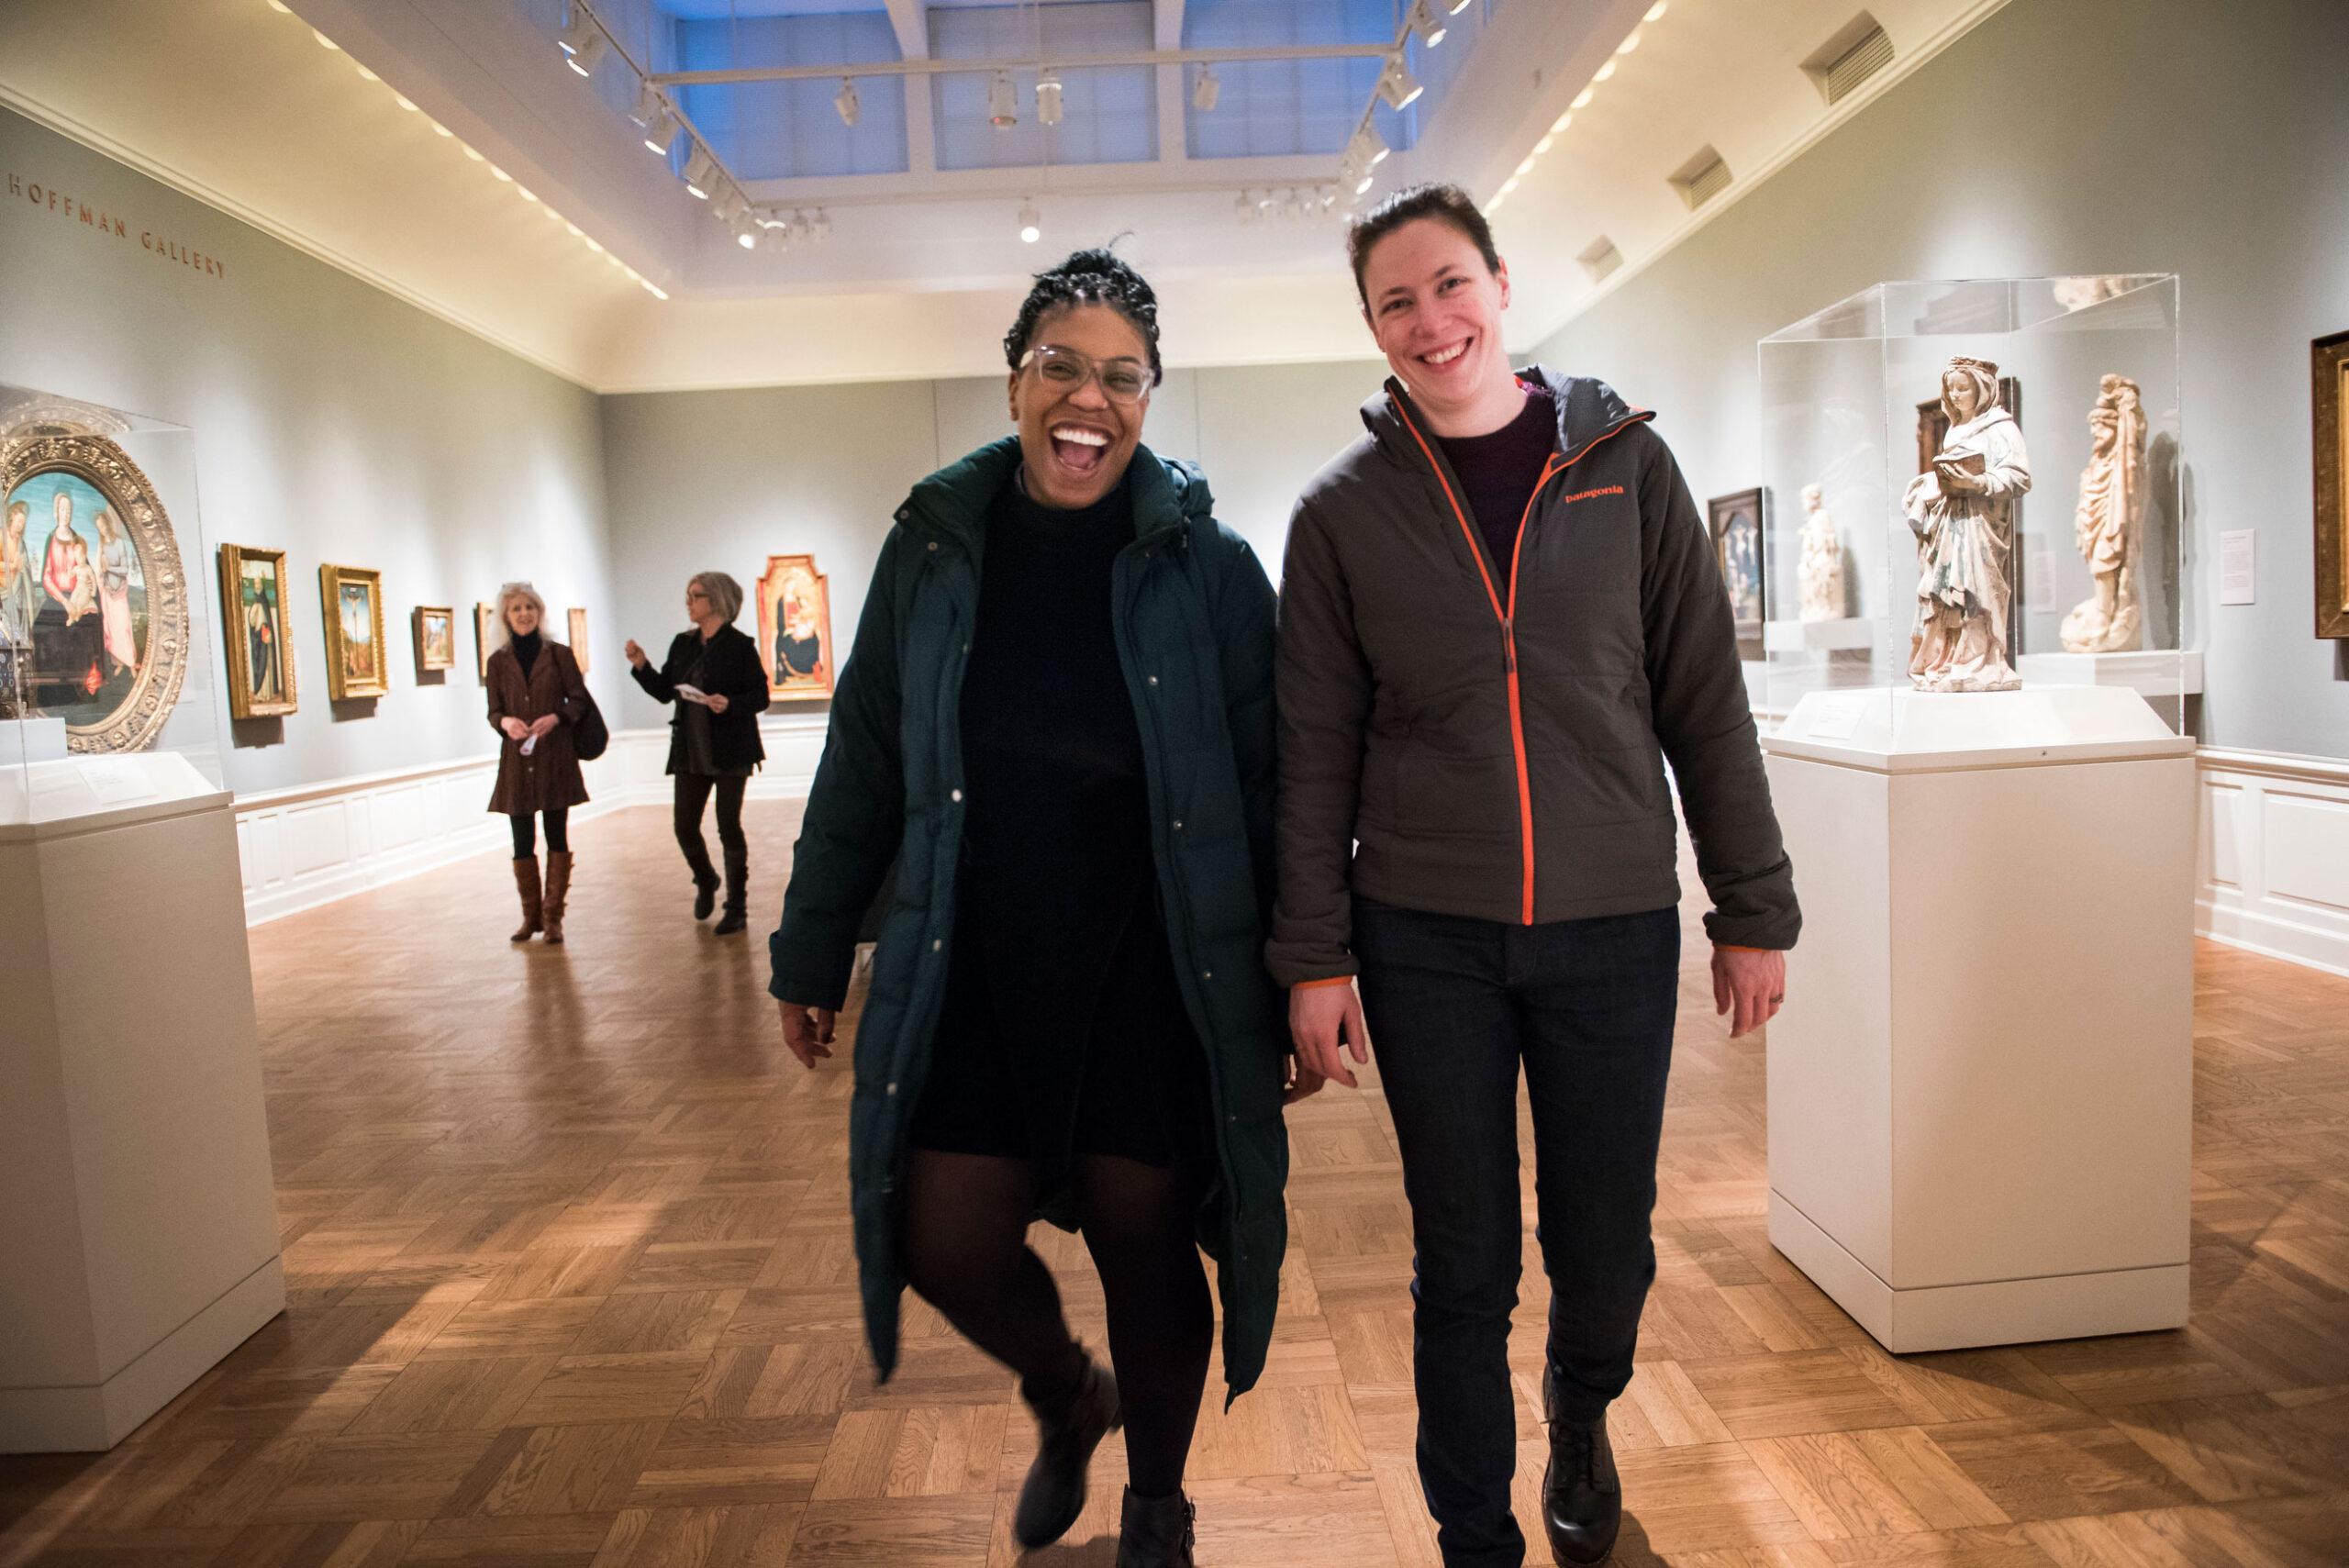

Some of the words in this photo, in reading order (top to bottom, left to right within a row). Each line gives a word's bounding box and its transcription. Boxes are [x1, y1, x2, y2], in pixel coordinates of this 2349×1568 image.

[8, 172, 126, 239] HOFFMAN
[141, 231, 224, 279] GALLERY
[1565, 484, 1623, 504] patagonia
